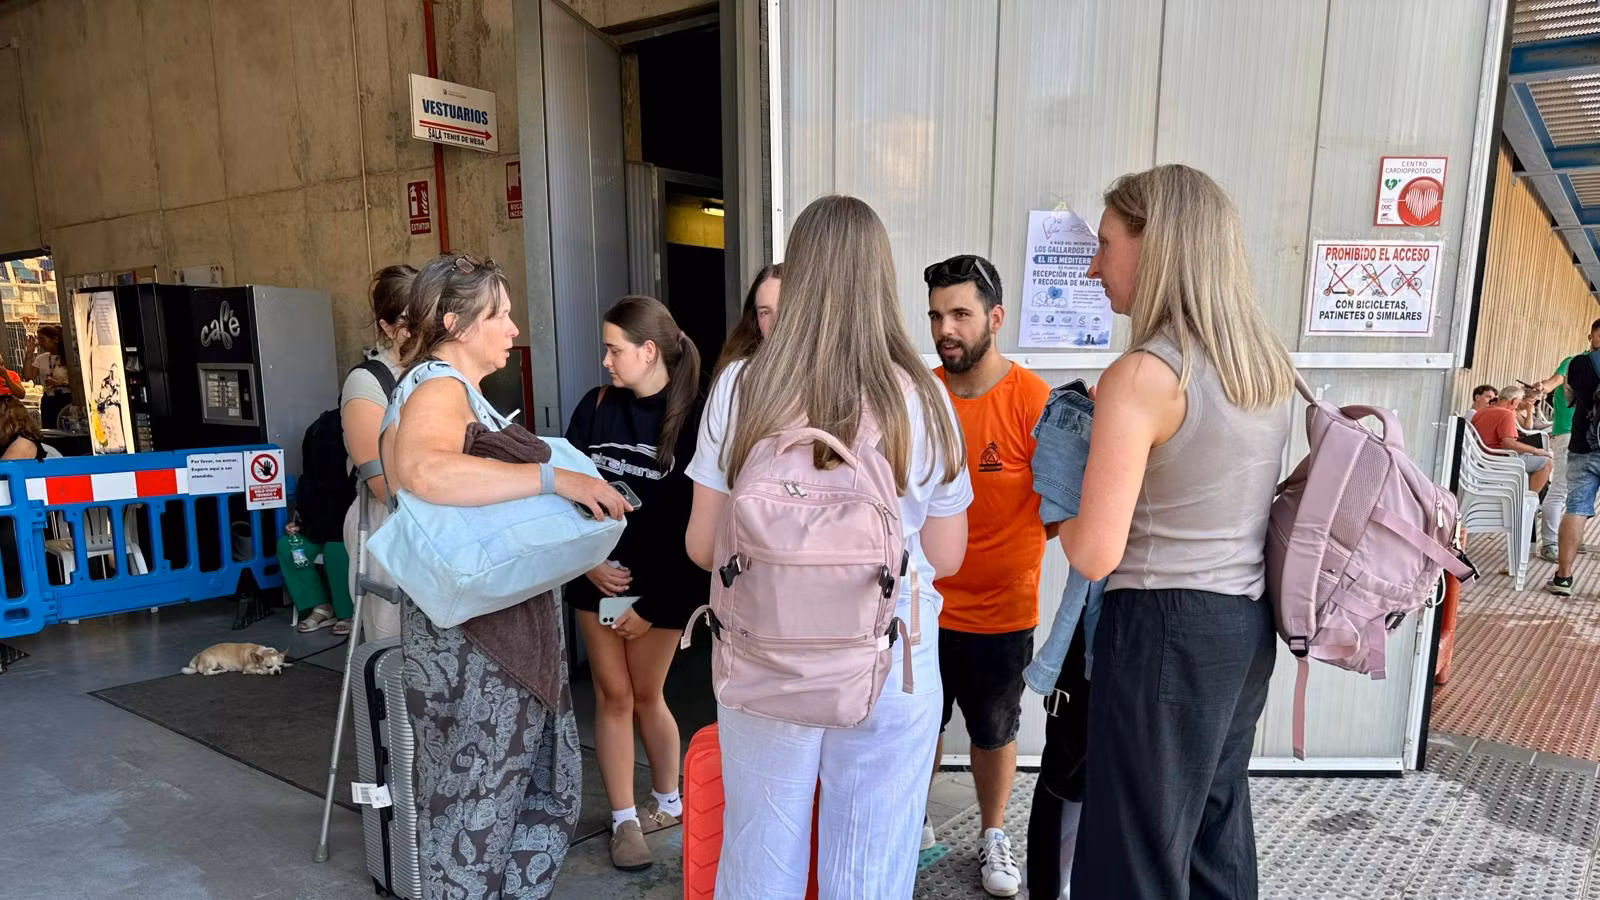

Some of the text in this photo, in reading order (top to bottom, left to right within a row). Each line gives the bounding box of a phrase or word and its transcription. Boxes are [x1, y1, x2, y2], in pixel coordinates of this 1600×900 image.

[422, 98, 488, 125] VESTUARIOS
[428, 127, 485, 146] SALA TENIS DE MESA
[411, 222, 430, 231] EXTINTOR
[1034, 245, 1046, 253] LOS
[1047, 246, 1085, 254] GALLARDOS
[1325, 247, 1430, 262] PROHIBIDO EL ACCESO
[1032, 269, 1067, 278] RECEPCIÓN
[1037, 278, 1069, 286] RECOGIDA
[1335, 299, 1408, 311] CON BICICLETAS,
[1319, 311, 1422, 320] PATINETES O SIMILARES
[200, 300, 241, 350] café
